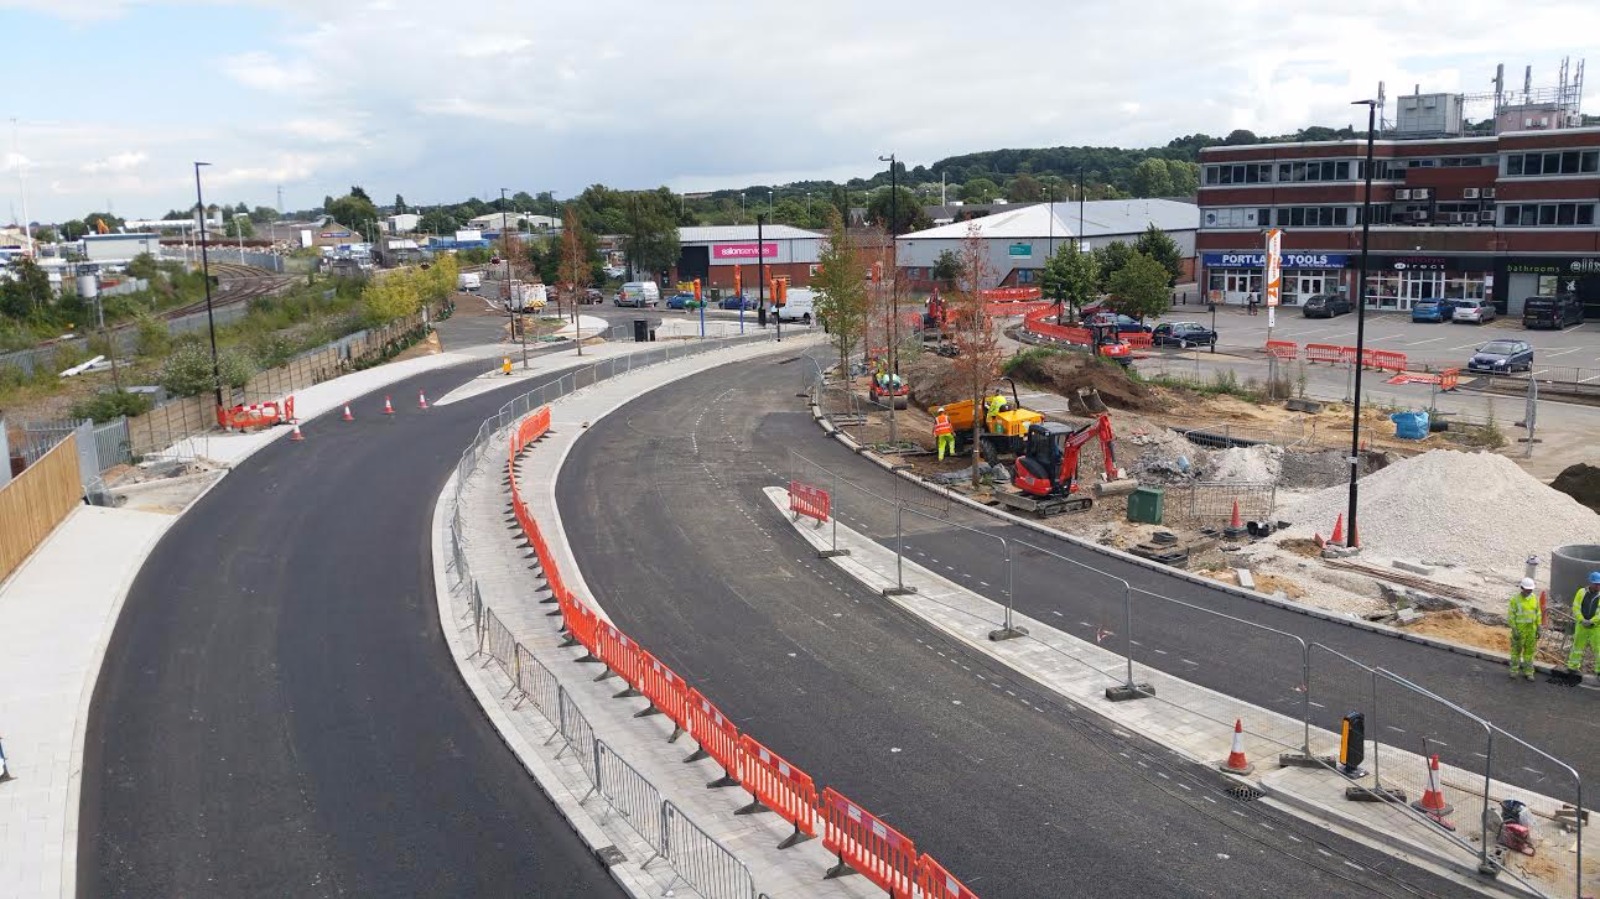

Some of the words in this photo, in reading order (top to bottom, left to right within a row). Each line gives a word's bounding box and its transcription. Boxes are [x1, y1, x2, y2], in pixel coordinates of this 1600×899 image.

[1222, 255, 1283, 264] PORTLA
[1287, 255, 1328, 265] TOOLS
[1507, 263, 1561, 273] bathrooms
